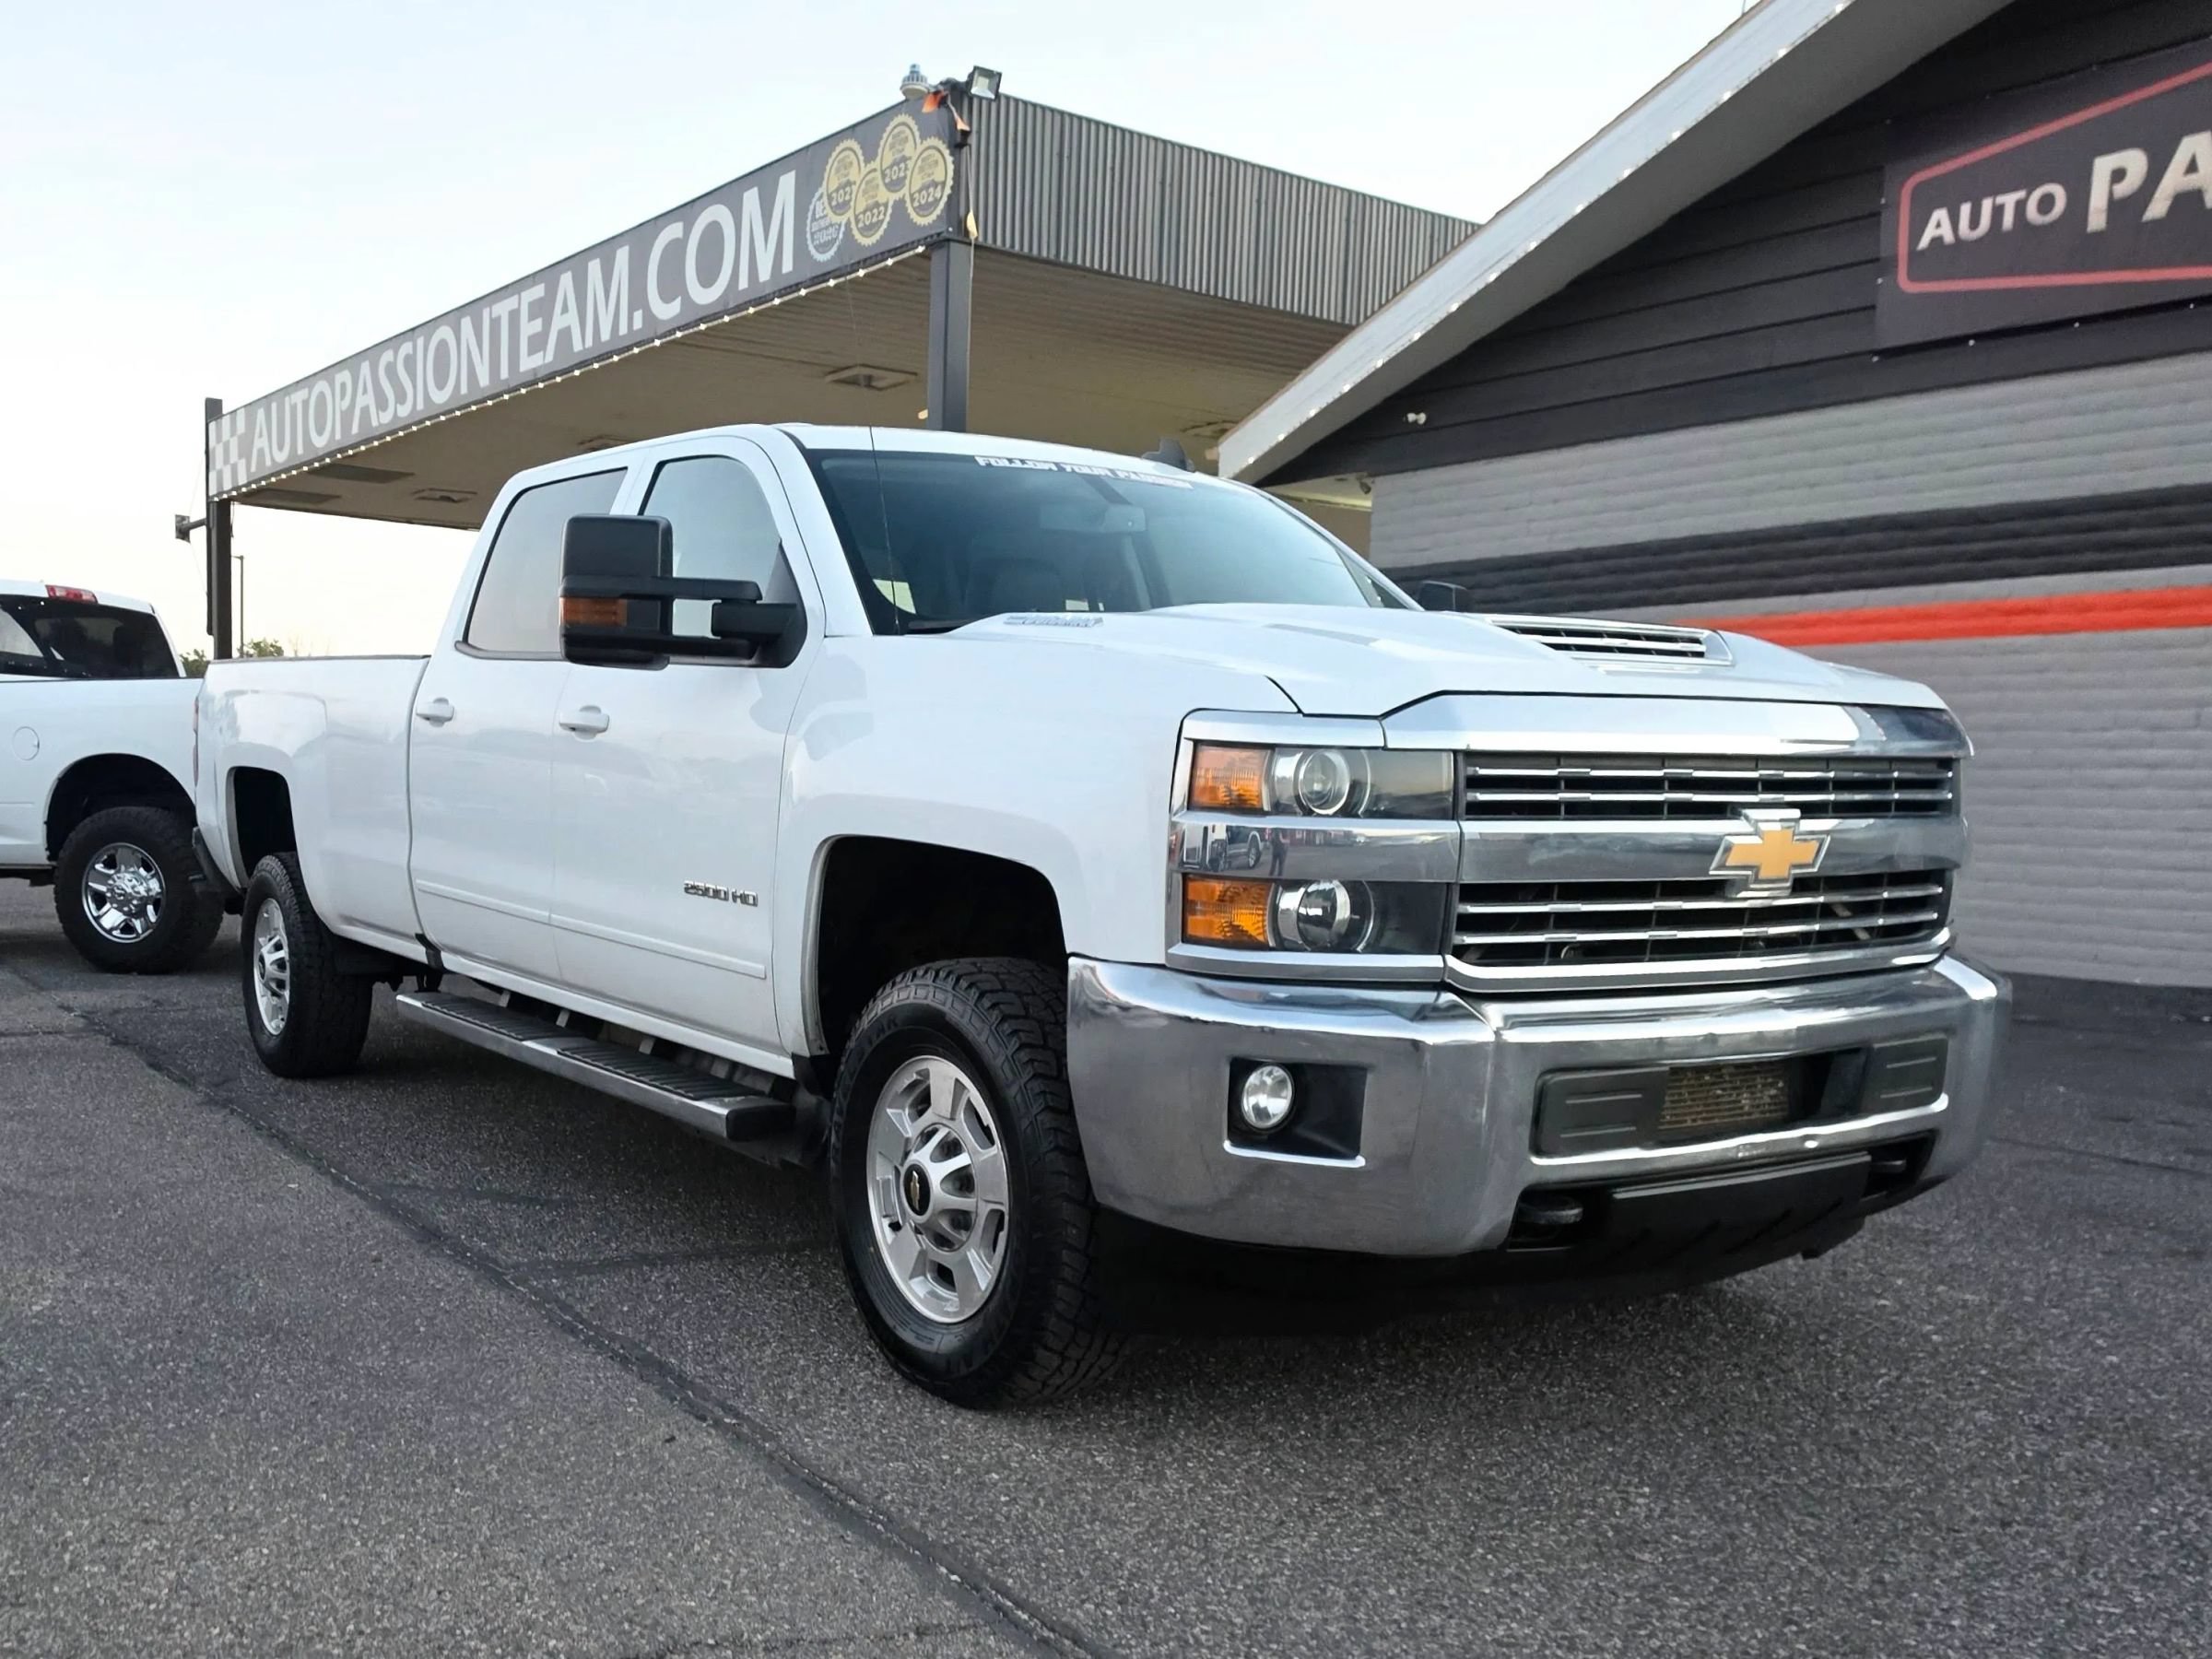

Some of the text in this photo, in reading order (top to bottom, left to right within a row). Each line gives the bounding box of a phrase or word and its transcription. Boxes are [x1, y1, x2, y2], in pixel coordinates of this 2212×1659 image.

[912, 186, 942, 207] 2024
[857, 206, 885, 229] 2022
[1915, 182, 2068, 252] AUTO
[250, 170, 796, 474] AUTOPASSIONTEAM.COM
[684, 879, 759, 908] 2500 HD
